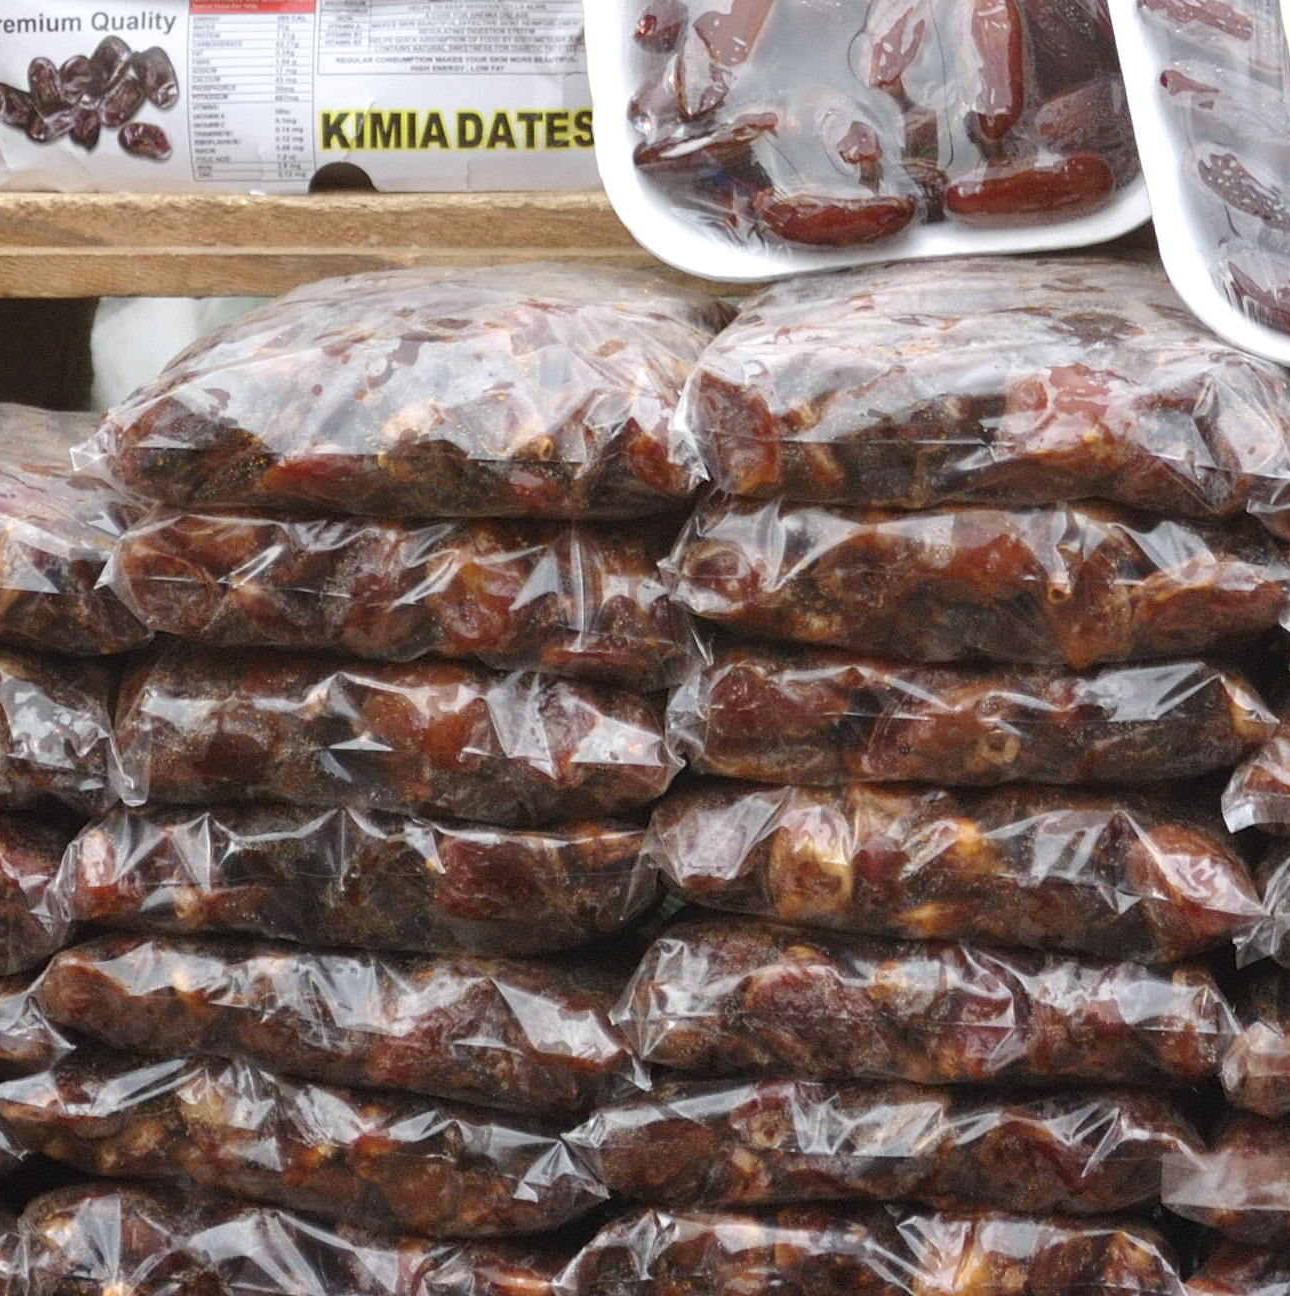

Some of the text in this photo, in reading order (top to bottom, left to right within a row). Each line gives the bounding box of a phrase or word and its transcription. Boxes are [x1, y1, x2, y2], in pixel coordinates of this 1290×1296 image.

[91, 11, 177, 35] Quality
[321, 109, 595, 149] KIMIA DATES
